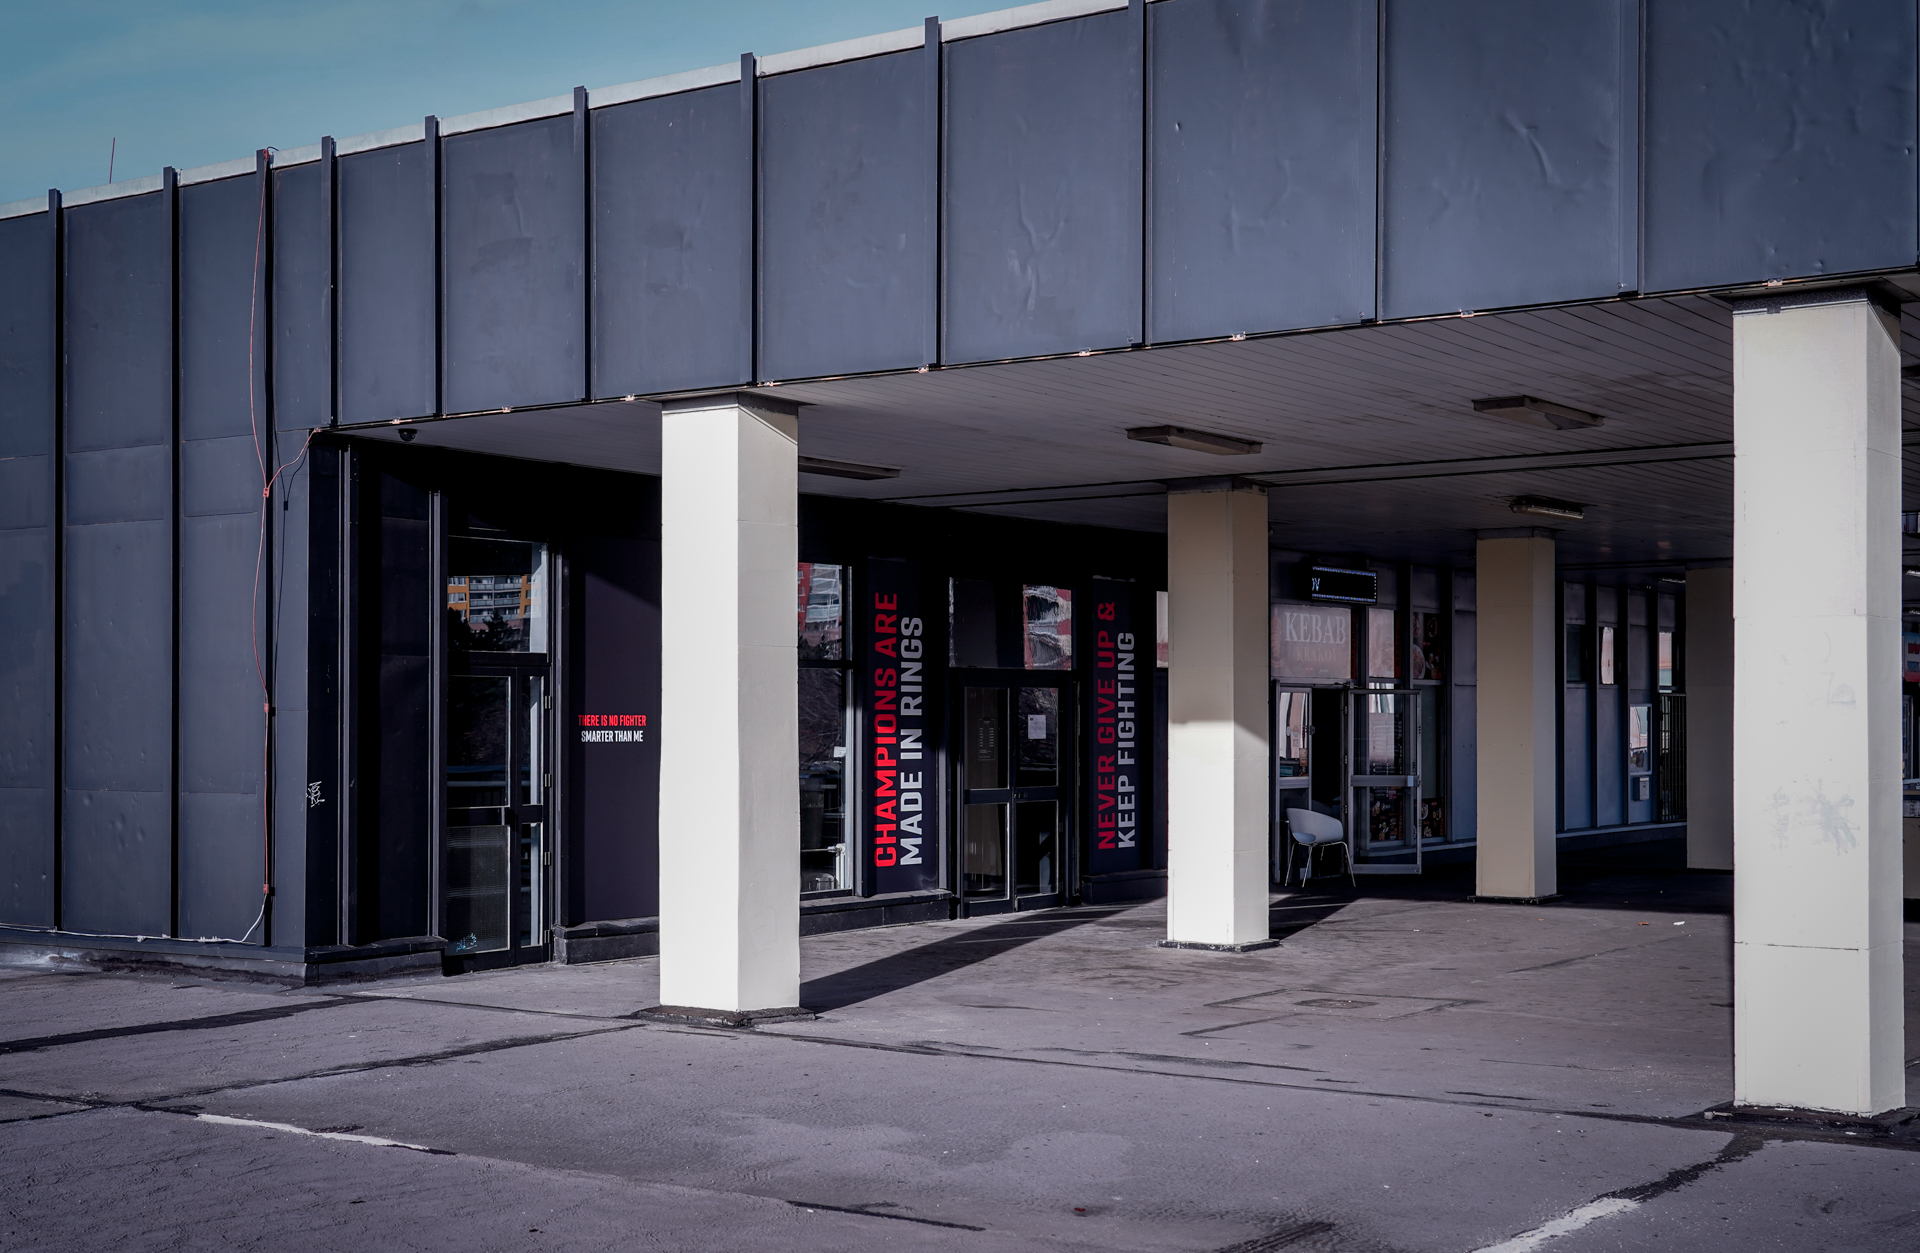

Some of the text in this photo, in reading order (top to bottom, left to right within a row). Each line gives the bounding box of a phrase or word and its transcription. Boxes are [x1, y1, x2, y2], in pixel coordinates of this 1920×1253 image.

[578, 714, 647, 727] THERE IS NO FIGHTER
[874, 592, 897, 868] CHAMPIONS ARE
[1097, 601, 1116, 850] NEVER GIVE UP &
[1284, 611, 1347, 645] KEBAB
[581, 730, 644, 743] SMARTER THAN ME
[900, 616, 923, 865] MADE IN RINGS
[1117, 632, 1136, 848] KEEP FIGHTING
